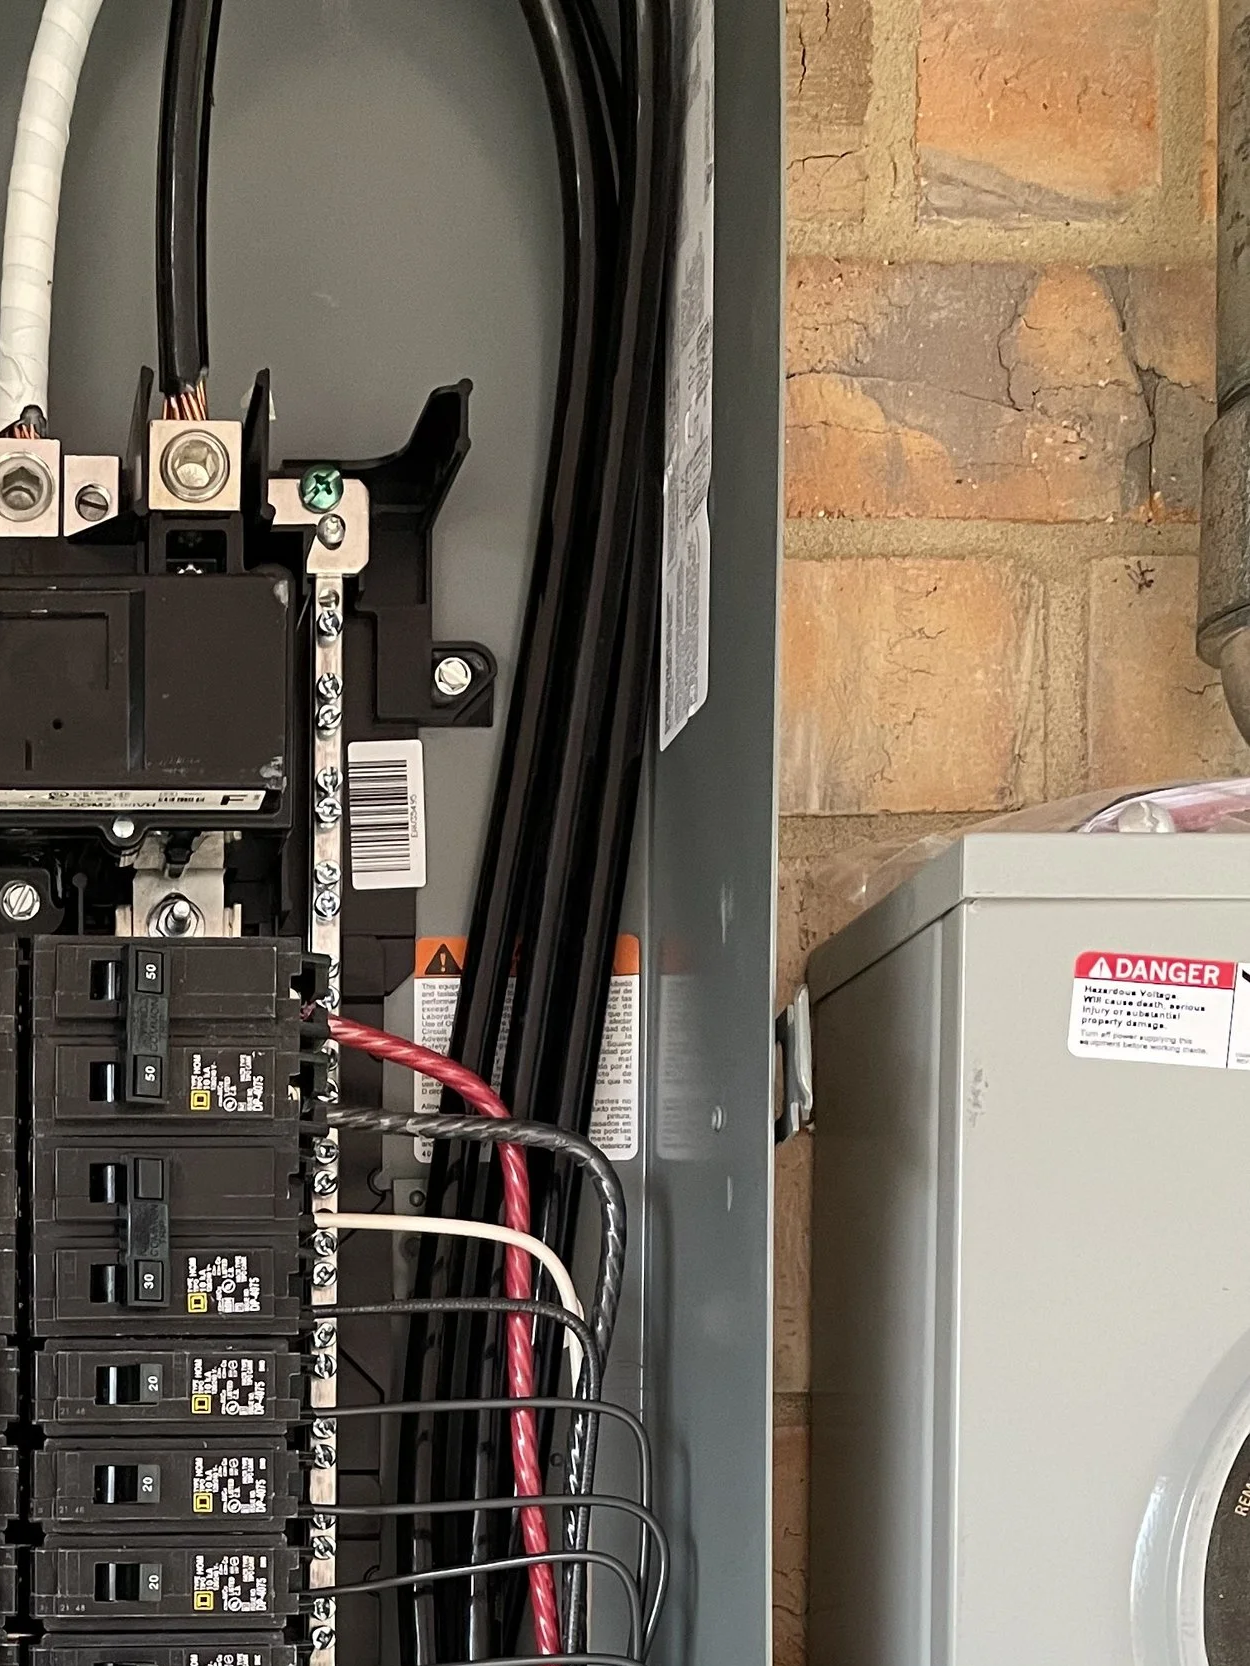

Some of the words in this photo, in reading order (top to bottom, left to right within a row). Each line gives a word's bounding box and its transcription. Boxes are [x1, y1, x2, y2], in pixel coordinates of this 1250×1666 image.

[146, 964, 156, 980] 50
[1116, 958, 1220, 985] DANGER
[1084, 986, 1136, 996] Hazardous
[1104, 998, 1133, 1006] cause
[1170, 1003, 1206, 1012] serious
[1082, 1017, 1122, 1028] property
[1126, 1010, 1180, 1020] substantial
[193, 1054, 201, 1074] HOM
[145, 1066, 155, 1082] 50
[252, 1076, 264, 1111] DP-4075
[188, 1257, 196, 1277] HOM
[144, 1274, 154, 1290] 30
[249, 1277, 260, 1311] DP-4075
[194, 1359, 202, 1378] HOM
[148, 1376, 158, 1391] 20
[254, 1381, 264, 1414] DP-4075
[195, 1458, 204, 1476] HOM
[142, 1476, 153, 1492] 20
[256, 1479, 266, 1513] DP-4075
[196, 1556, 204, 1575] HOM
[148, 1574, 159, 1590] 20
[256, 1578, 266, 1611] DP-4075
